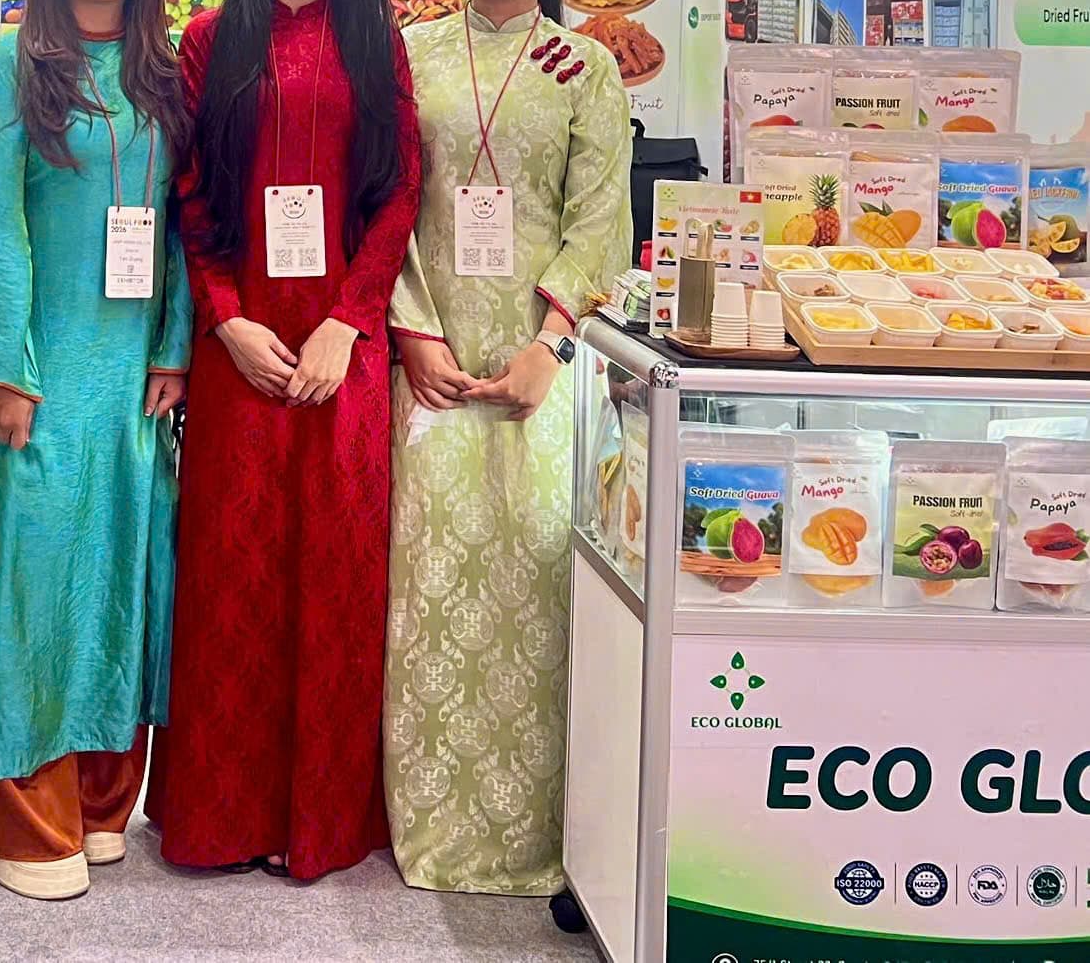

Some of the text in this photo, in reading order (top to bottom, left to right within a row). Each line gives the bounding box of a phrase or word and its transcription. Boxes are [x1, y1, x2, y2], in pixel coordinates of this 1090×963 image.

[1044, 8, 1070, 24] Dried
[630, 94, 663, 111] Fruit
[753, 94, 796, 109] Papaya
[835, 97, 901, 109] PASSION FRUIT
[935, 95, 975, 109] Mango
[776, 184, 797, 192] Dried
[854, 182, 894, 196] Mango
[959, 183, 987, 193] Dried
[988, 184, 1018, 194] Guava
[765, 192, 803, 203] eapple
[689, 486, 780, 501] Soft Dried Guava
[800, 484, 845, 500] Mango
[912, 494, 956, 509] PASSION
[1029, 497, 1077, 516] Papaya
[691, 716, 783, 731] ECO GLOBAL
[766, 745, 932, 813] ECO
[836, 879, 883, 889] ISO 22000
[914, 881, 939, 889] HACCP
[977, 880, 999, 890] FDA
